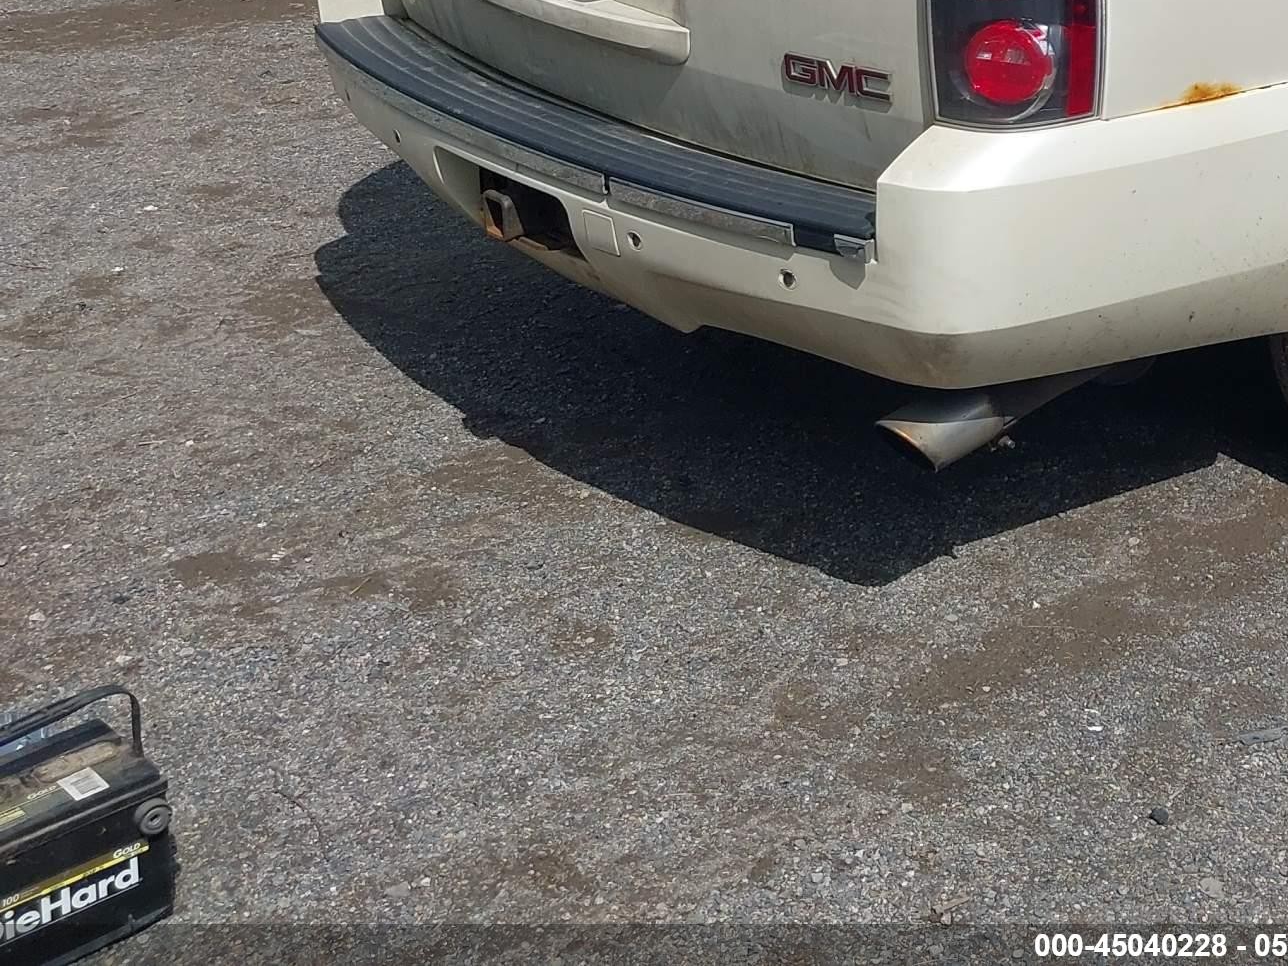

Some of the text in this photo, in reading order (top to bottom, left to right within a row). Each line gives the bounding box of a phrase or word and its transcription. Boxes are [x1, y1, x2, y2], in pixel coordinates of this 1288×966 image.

[783, 51, 893, 102] GMC
[112, 841, 141, 860] GOLD
[0, 856, 141, 940] ieHard
